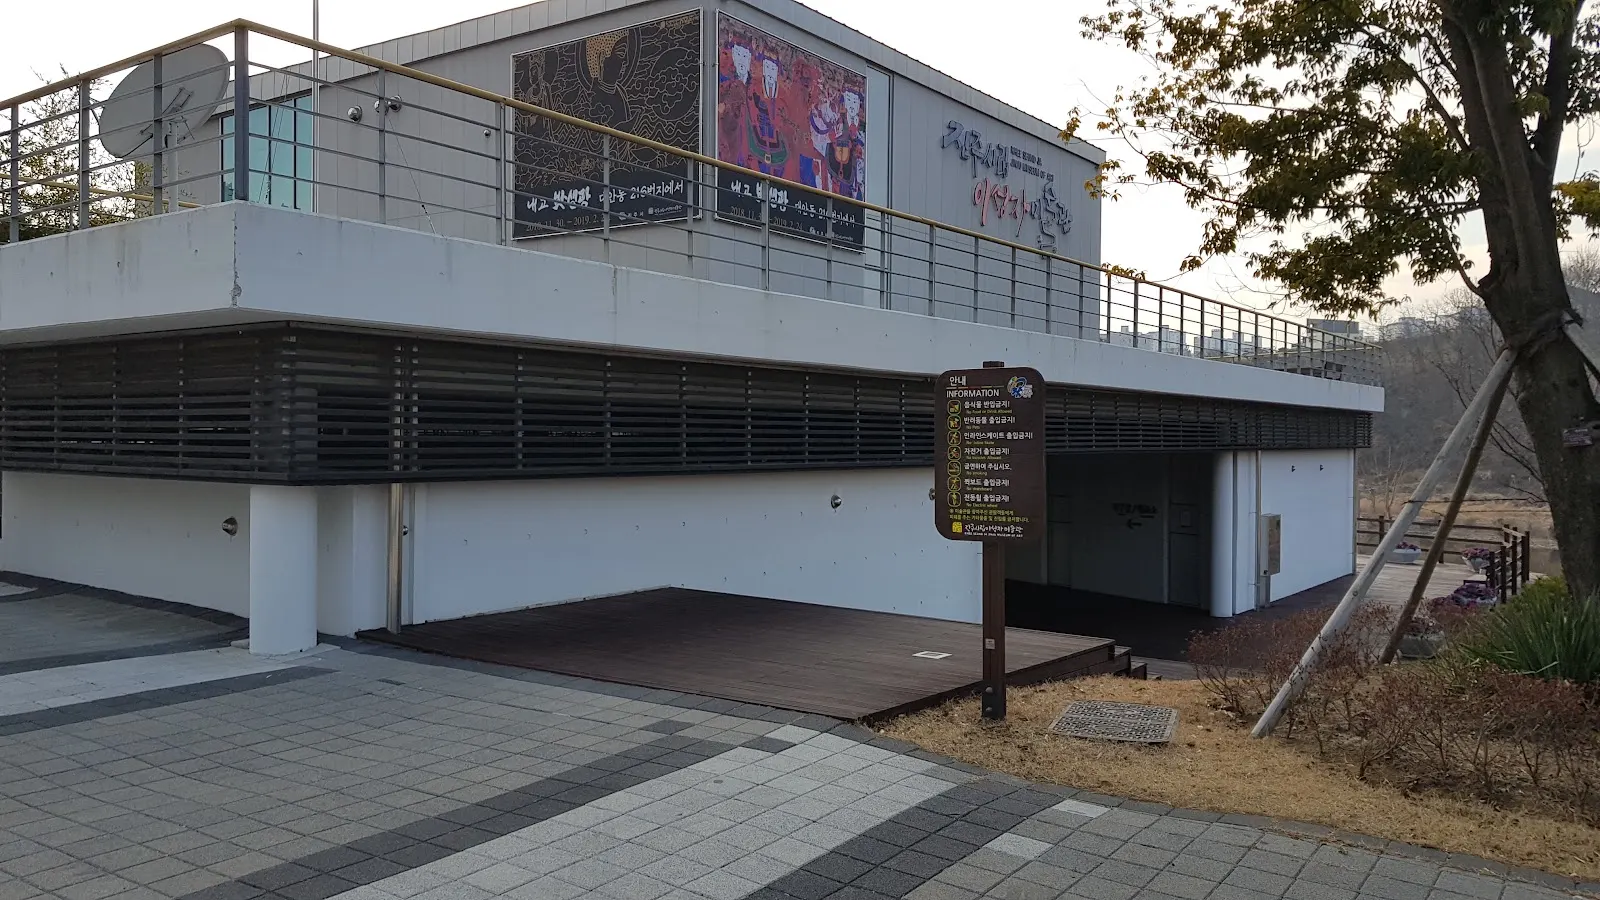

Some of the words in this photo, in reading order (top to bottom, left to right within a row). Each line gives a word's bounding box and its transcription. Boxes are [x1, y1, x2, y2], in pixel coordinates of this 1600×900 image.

[526, 197, 549, 213] 내고
[949, 375, 967, 386] 안내
[946, 389, 1000, 398] INFORMATION
[964, 401, 982, 409] 음식물
[983, 401, 1010, 409] 반입금지!
[963, 416, 987, 425] 반려동물
[988, 416, 1016, 424] 출입금지!
[1006, 432, 1033, 440] 출입금지!
[964, 448, 982, 456] 자전거
[983, 448, 1010, 456] 출입금지!
[983, 478, 1010, 487] 출입금지!
[983, 494, 1010, 502] 출입금지!
